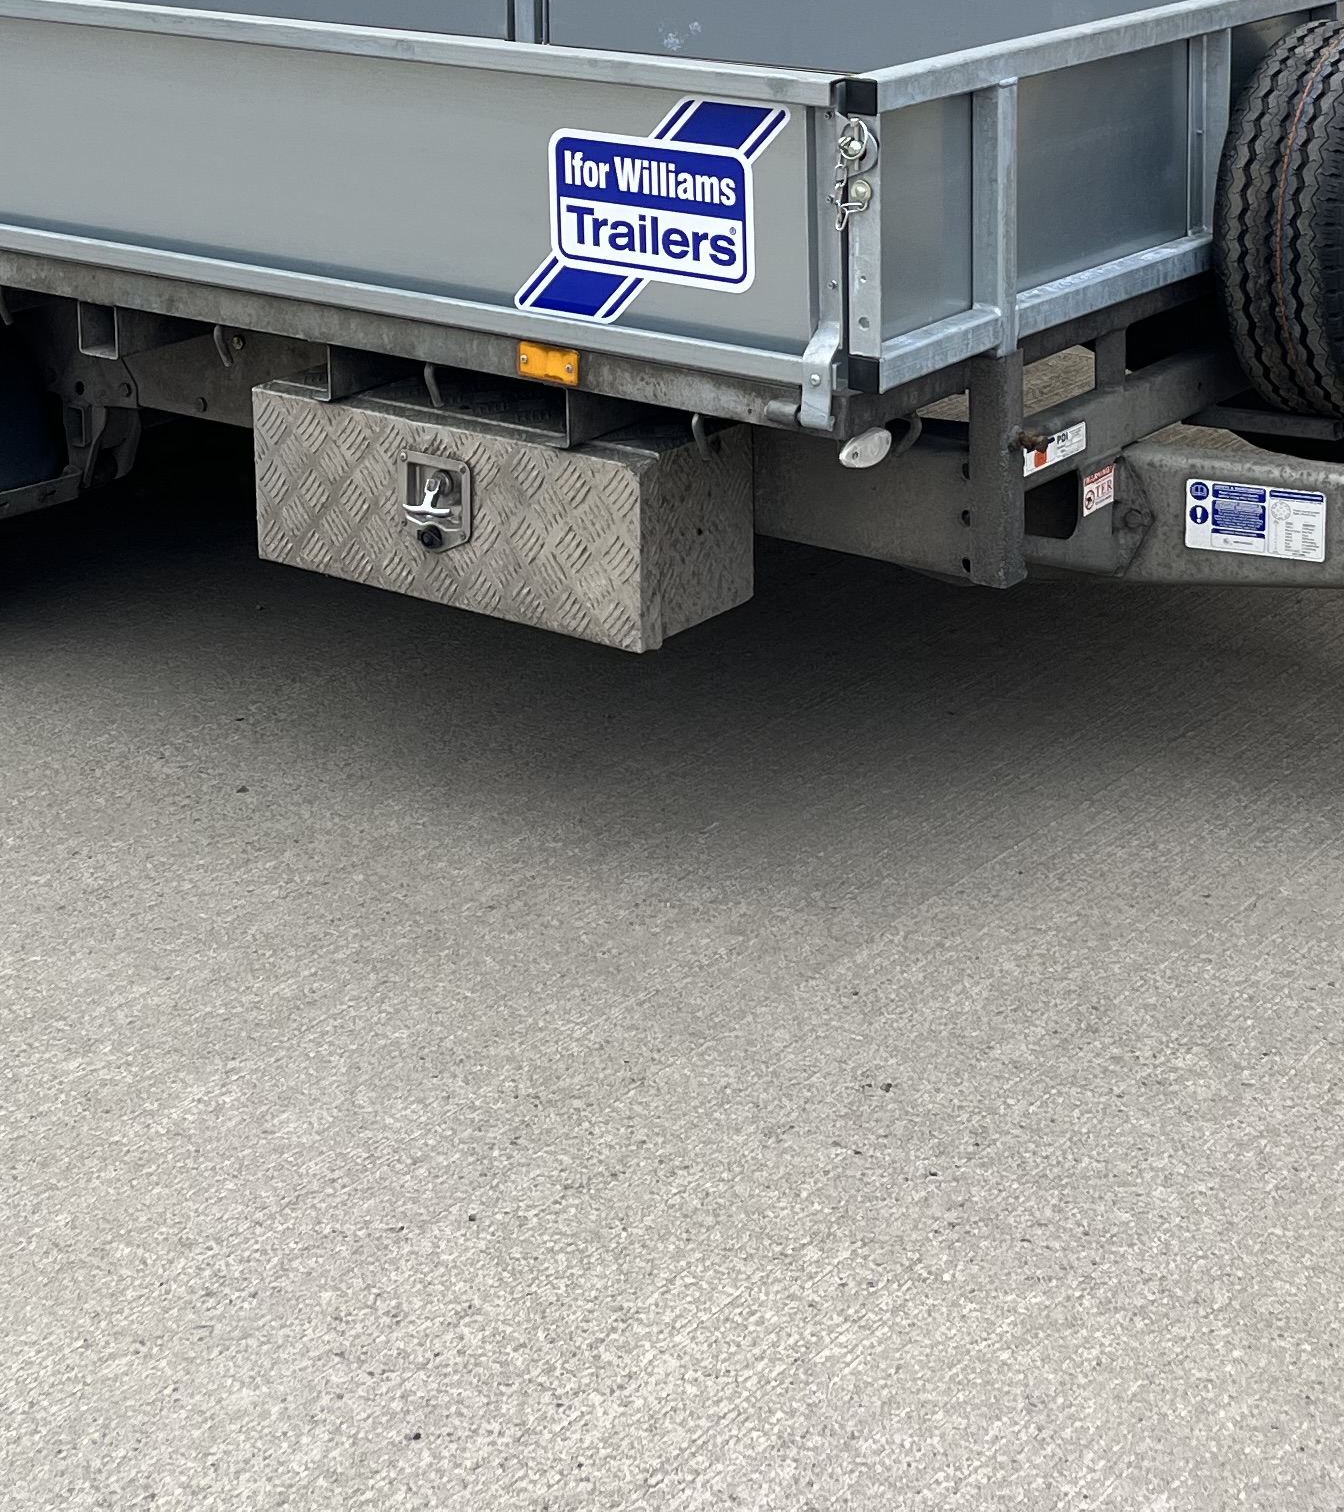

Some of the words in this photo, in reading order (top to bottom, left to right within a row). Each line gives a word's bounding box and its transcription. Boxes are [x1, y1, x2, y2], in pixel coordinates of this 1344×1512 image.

[564, 150, 610, 189] Ifor
[613, 156, 737, 207] Williams
[566, 204, 738, 267] Trailers
